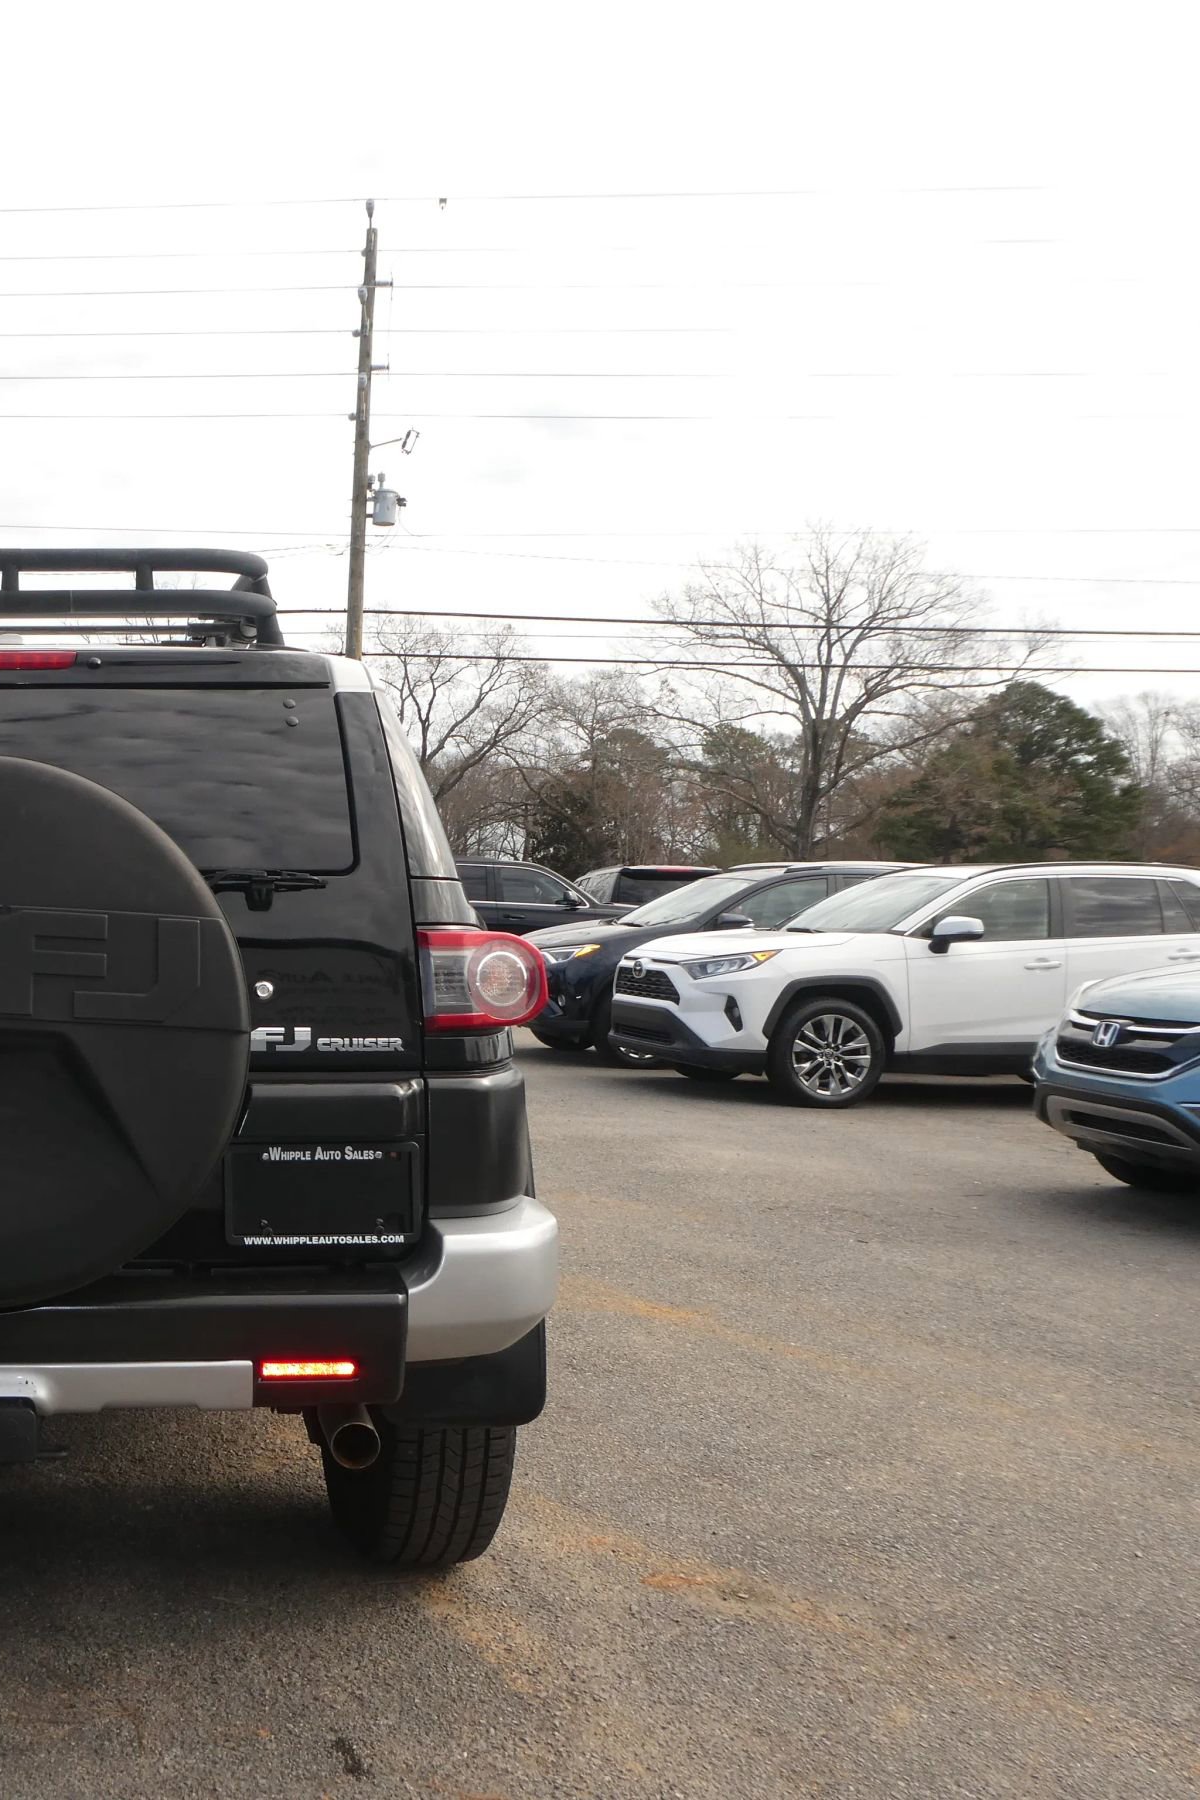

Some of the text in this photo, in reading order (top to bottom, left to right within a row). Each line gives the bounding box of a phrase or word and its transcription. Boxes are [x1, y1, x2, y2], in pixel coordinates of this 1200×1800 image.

[250, 1026, 404, 1052] FJ CRUISER
[244, 1234, 405, 1246] WWW.WHIPPLEAUTOSALES.COM
